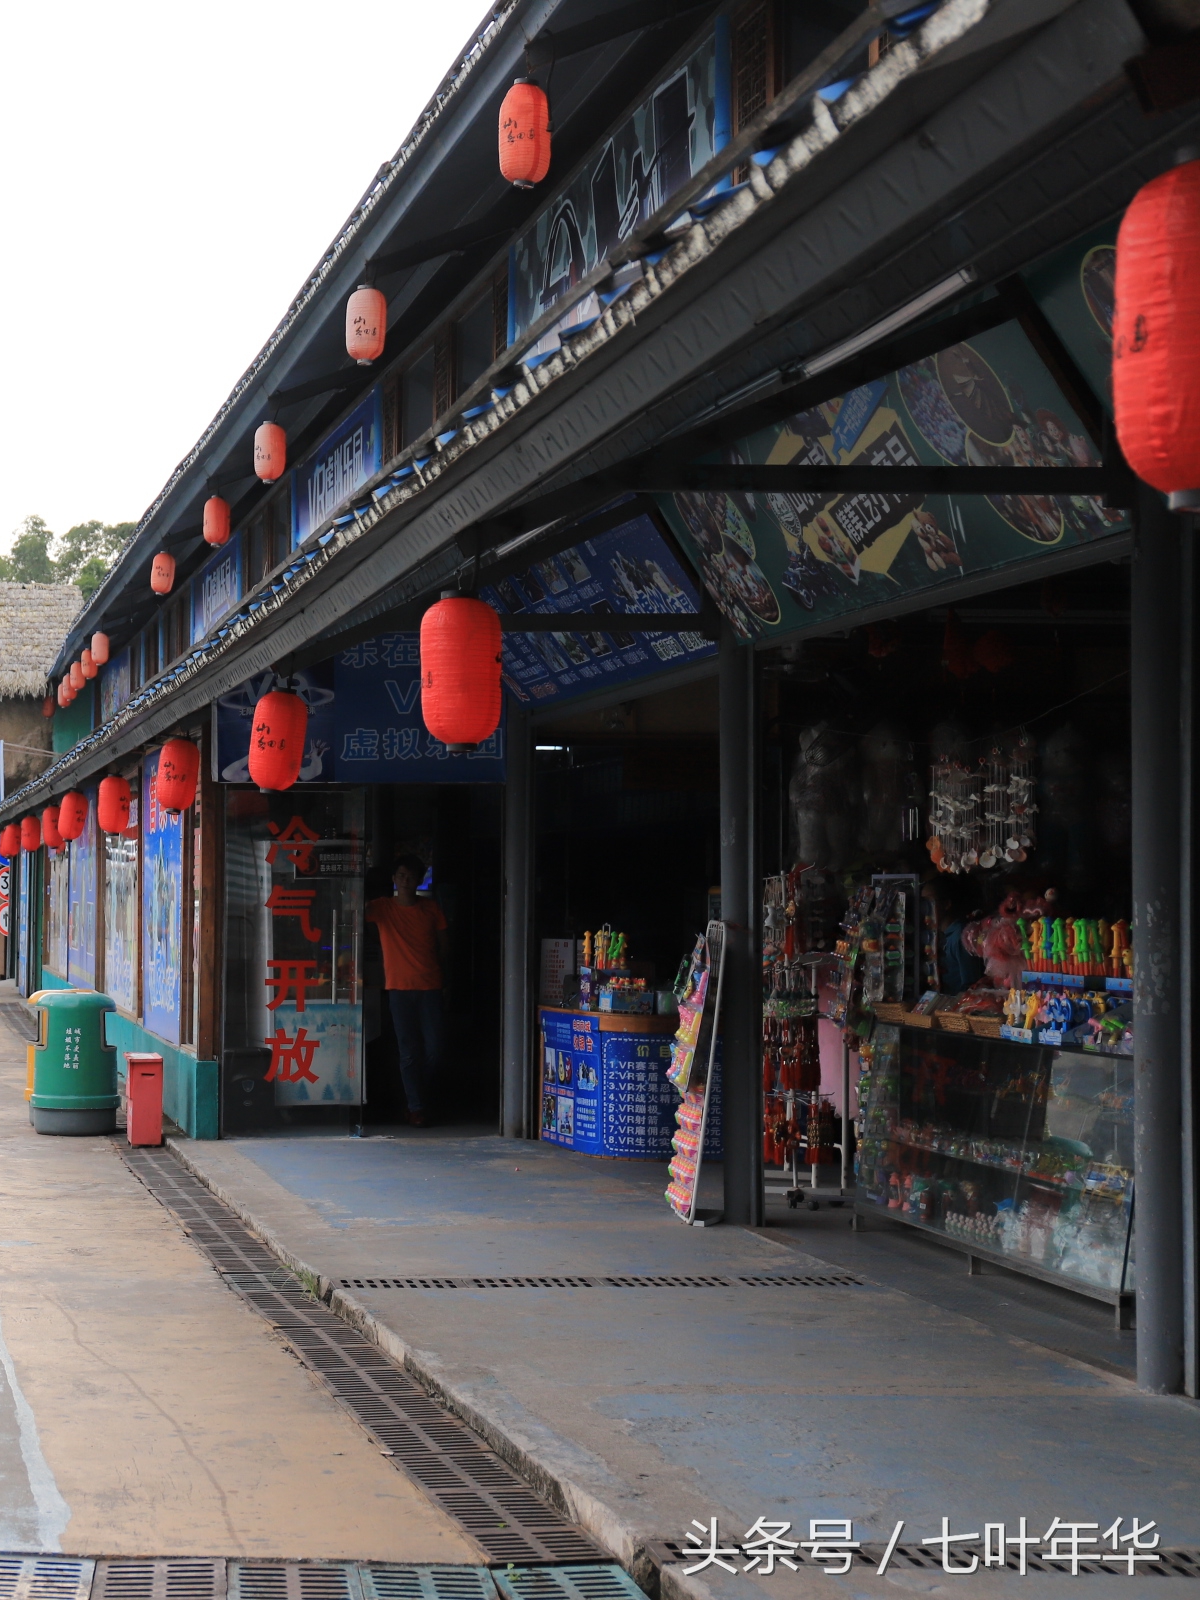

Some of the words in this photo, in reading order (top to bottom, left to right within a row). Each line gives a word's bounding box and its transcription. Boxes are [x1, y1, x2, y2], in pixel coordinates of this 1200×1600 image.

[264, 815, 322, 1084] 冷气开放
[609, 1061, 658, 1071] 1.VR赛车
[609, 1072, 658, 1082] 2.VR音盾
[609, 1115, 658, 1125] 6.VR射箭
